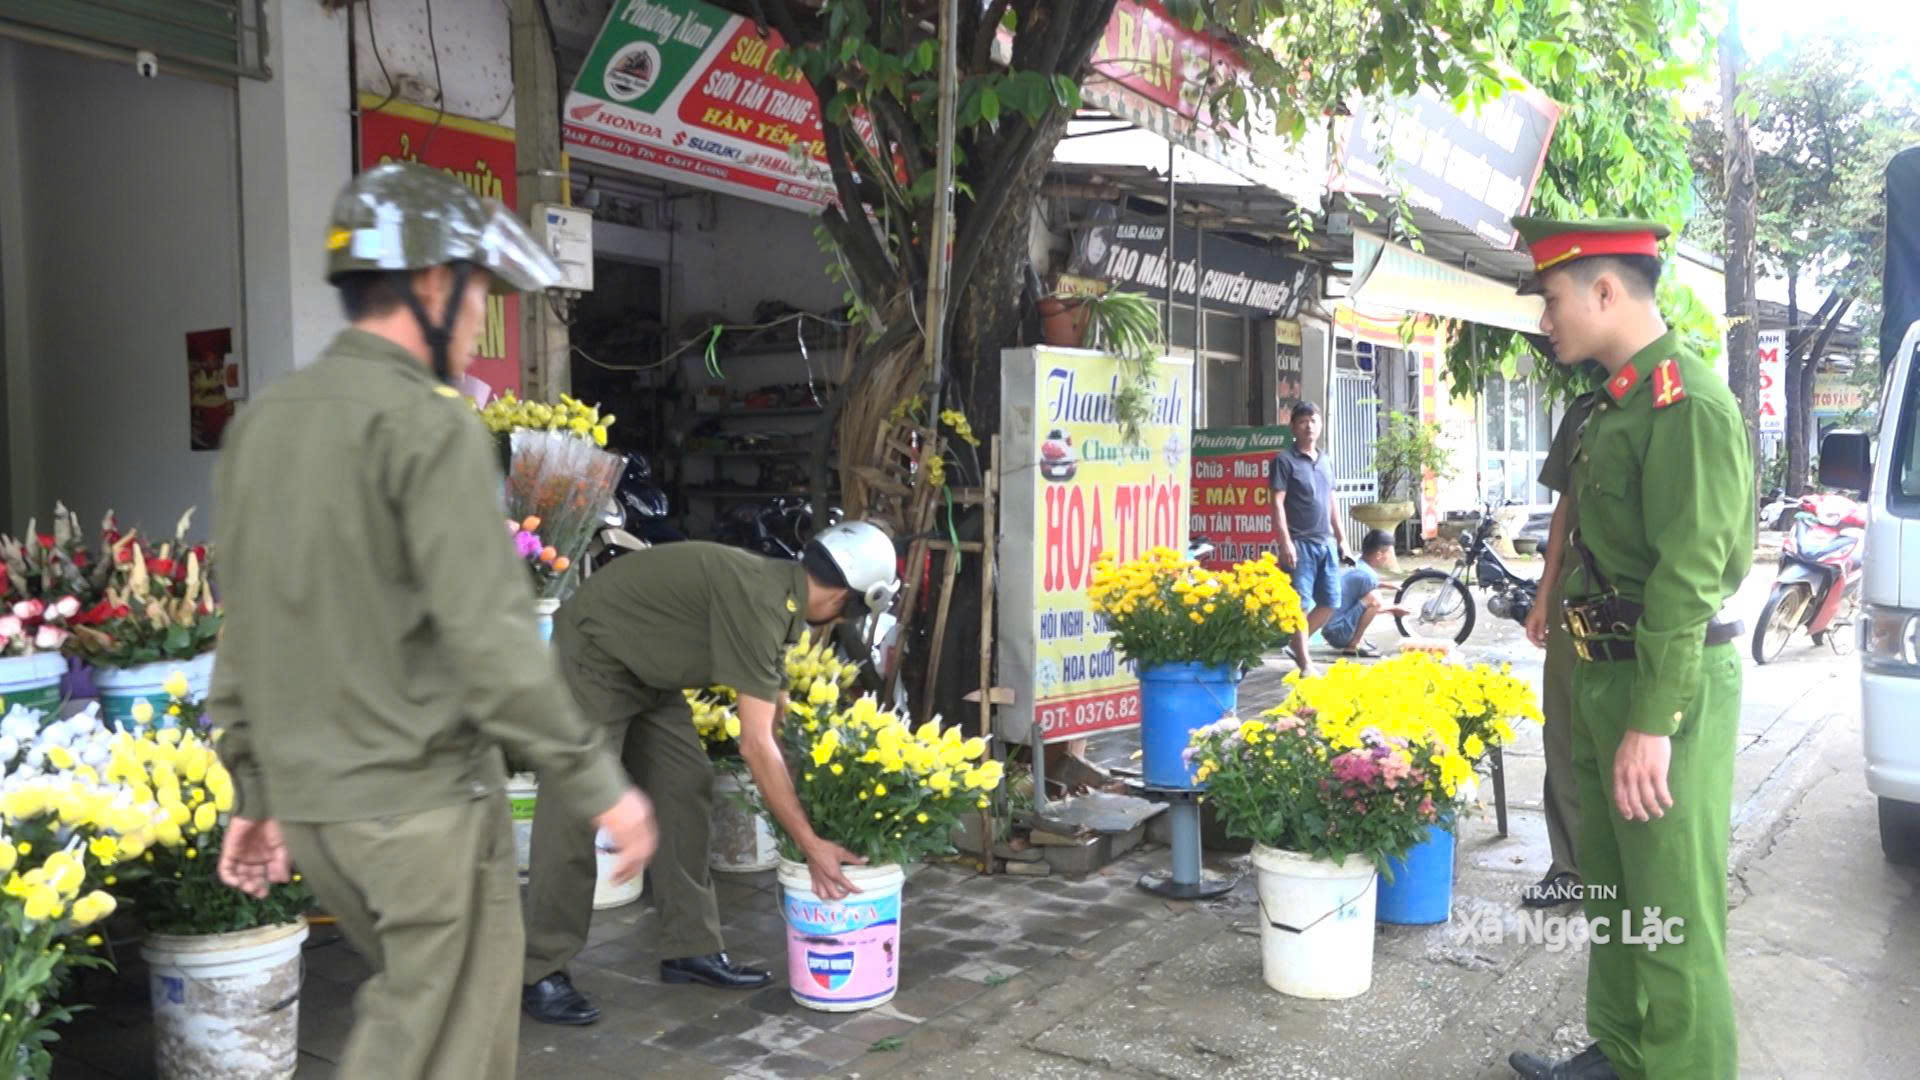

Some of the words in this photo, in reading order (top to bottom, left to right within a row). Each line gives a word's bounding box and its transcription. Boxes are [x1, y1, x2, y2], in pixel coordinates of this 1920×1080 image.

[673, 9, 712, 48] Nam
[764, 88, 813, 125] TRANG
[597, 111, 663, 139] HONDA
[687, 137, 742, 159] SUZUKI
[1104, 244, 1140, 284] TẠO
[1192, 433, 1247, 450] Phương
[1248, 432, 1285, 446] Nam
[1234, 460, 1259, 479] Mua
[1205, 484, 1248, 505] MÁY
[1044, 484, 1104, 593] HOA
[1114, 473, 1182, 566] TƯƠI
[1190, 514, 1207, 533] ƠN
[1235, 514, 1273, 533] TRANG
[1240, 543, 1257, 561] XE
[1040, 607, 1057, 646] HỘI
[1060, 610, 1084, 642] NGHỊ
[1063, 655, 1086, 682] HOA
[1041, 708, 1070, 732] ĐT:
[1075, 695, 1138, 726] 0376.82
